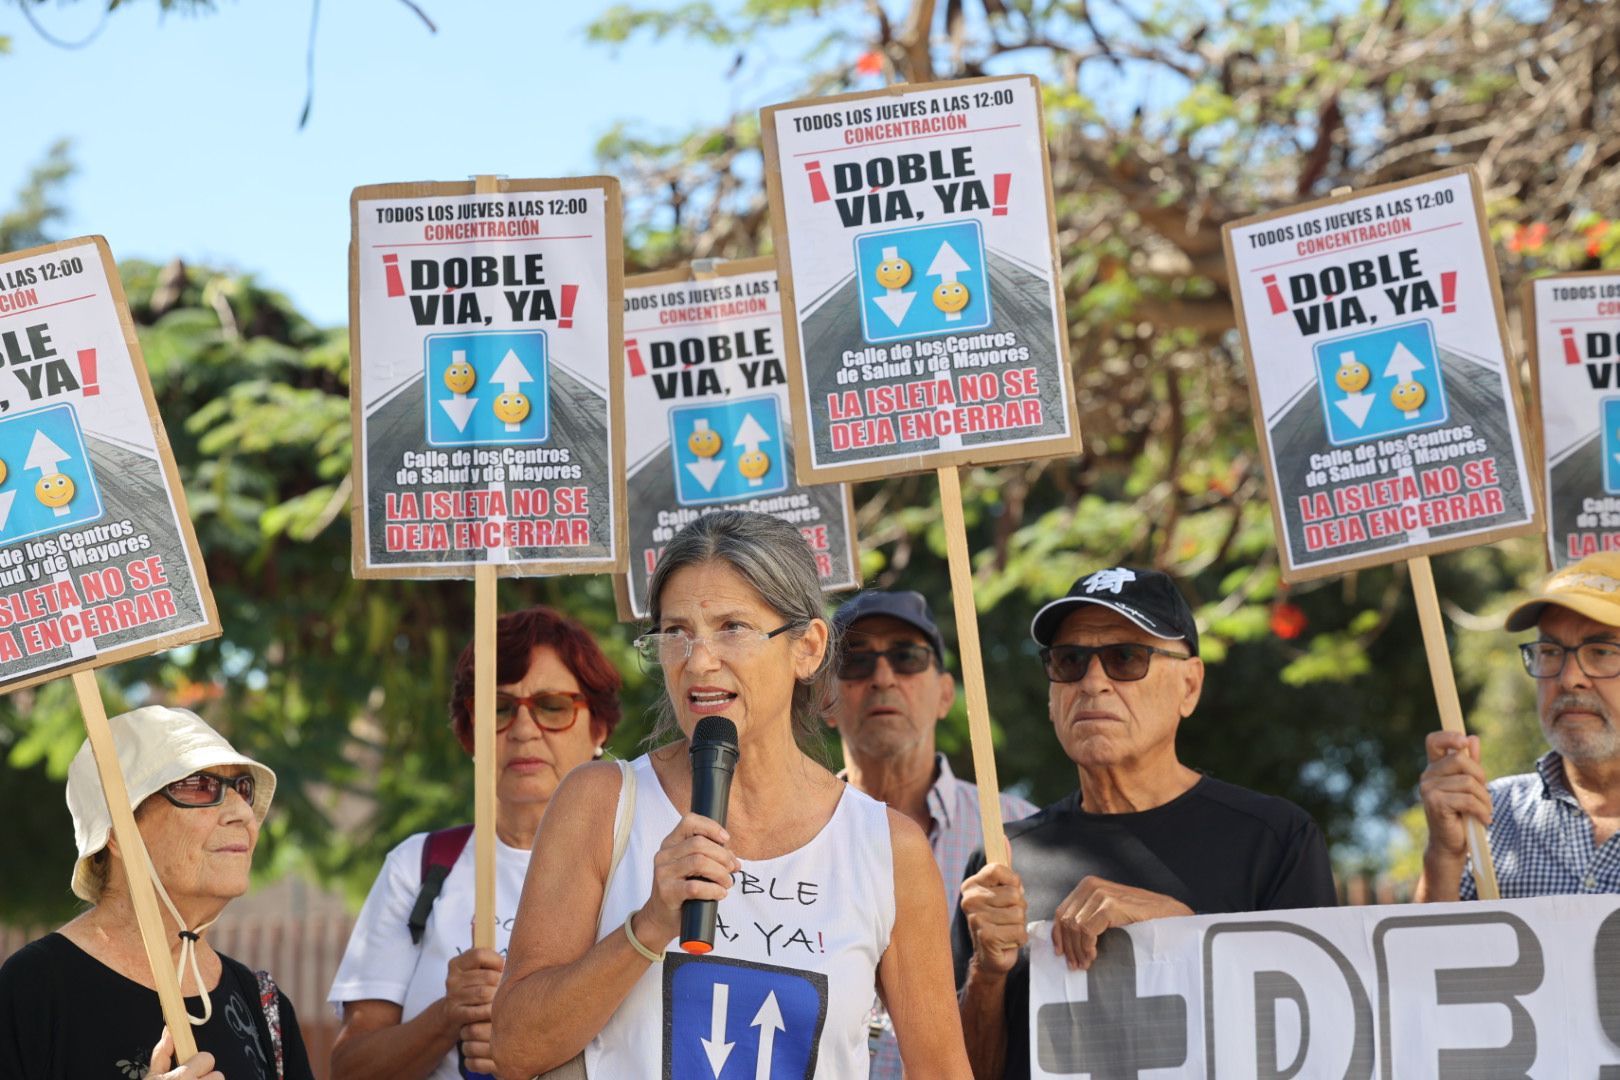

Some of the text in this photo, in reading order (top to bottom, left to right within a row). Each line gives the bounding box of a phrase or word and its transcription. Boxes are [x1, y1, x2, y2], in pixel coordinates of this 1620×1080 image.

[794, 88, 1014, 132] TODOS LOS JUEVES A LAS 12:00
[844, 112, 968, 144] CONCENTRACIÓN
[376, 198, 588, 224] TODOS LOS JUEVES A LAS 12:00
[835, 186, 924, 228] VÍA,
[1248, 188, 1454, 249] TODOS LOS JUEVES A LAS 12:00
[424, 218, 540, 241] CONCENTRACIÓN
[1296, 216, 1412, 256] CONCENTRACIÓN
[7, 268, 38, 289] LAS
[38, 256, 83, 282] 12:00
[410, 287, 493, 326] VÍA,
[624, 295, 658, 312] ODOS
[662, 292, 684, 307] LOS
[688, 285, 732, 304] JUEVES
[735, 284, 744, 297] A
[746, 280, 770, 296] LAS
[660, 297, 767, 324] CONCENTRACIÓN
[1552, 286, 1596, 301] TODOS
[1292, 294, 1377, 336] VÍA,
[0, 323, 57, 368] LE
[836, 346, 1029, 384] de Salud y de Mayores
[842, 332, 1016, 368] Calle de los Centros
[652, 358, 786, 400] VÍA, YA
[828, 367, 1039, 421] LA ISLETA NO SE
[831, 399, 1043, 452] DEJA ENCERRAR
[404, 448, 570, 469] Calle de los Centros
[1306, 438, 1488, 488] de Salud y de Mayores
[1310, 424, 1473, 471] Calle de los Centros
[396, 464, 582, 486] de Salud y de Mayores
[1299, 457, 1499, 524] LA ISLETA NO SE
[385, 486, 590, 520] LA ISLETA NO SE
[1304, 488, 1506, 552] DEJA ENCERRAR
[25, 540, 58, 561] los
[58, 519, 134, 551] Centros
[386, 518, 590, 552] DEJA ENCERRAR
[652, 528, 673, 542] de
[0, 533, 150, 588] ud y de Mayores
[80, 566, 126, 604] NO
[126, 554, 168, 590] SE
[21, 588, 178, 656] ENCERRAR
[731, 870, 818, 905] BLE
[754, 921, 825, 956] YA!
